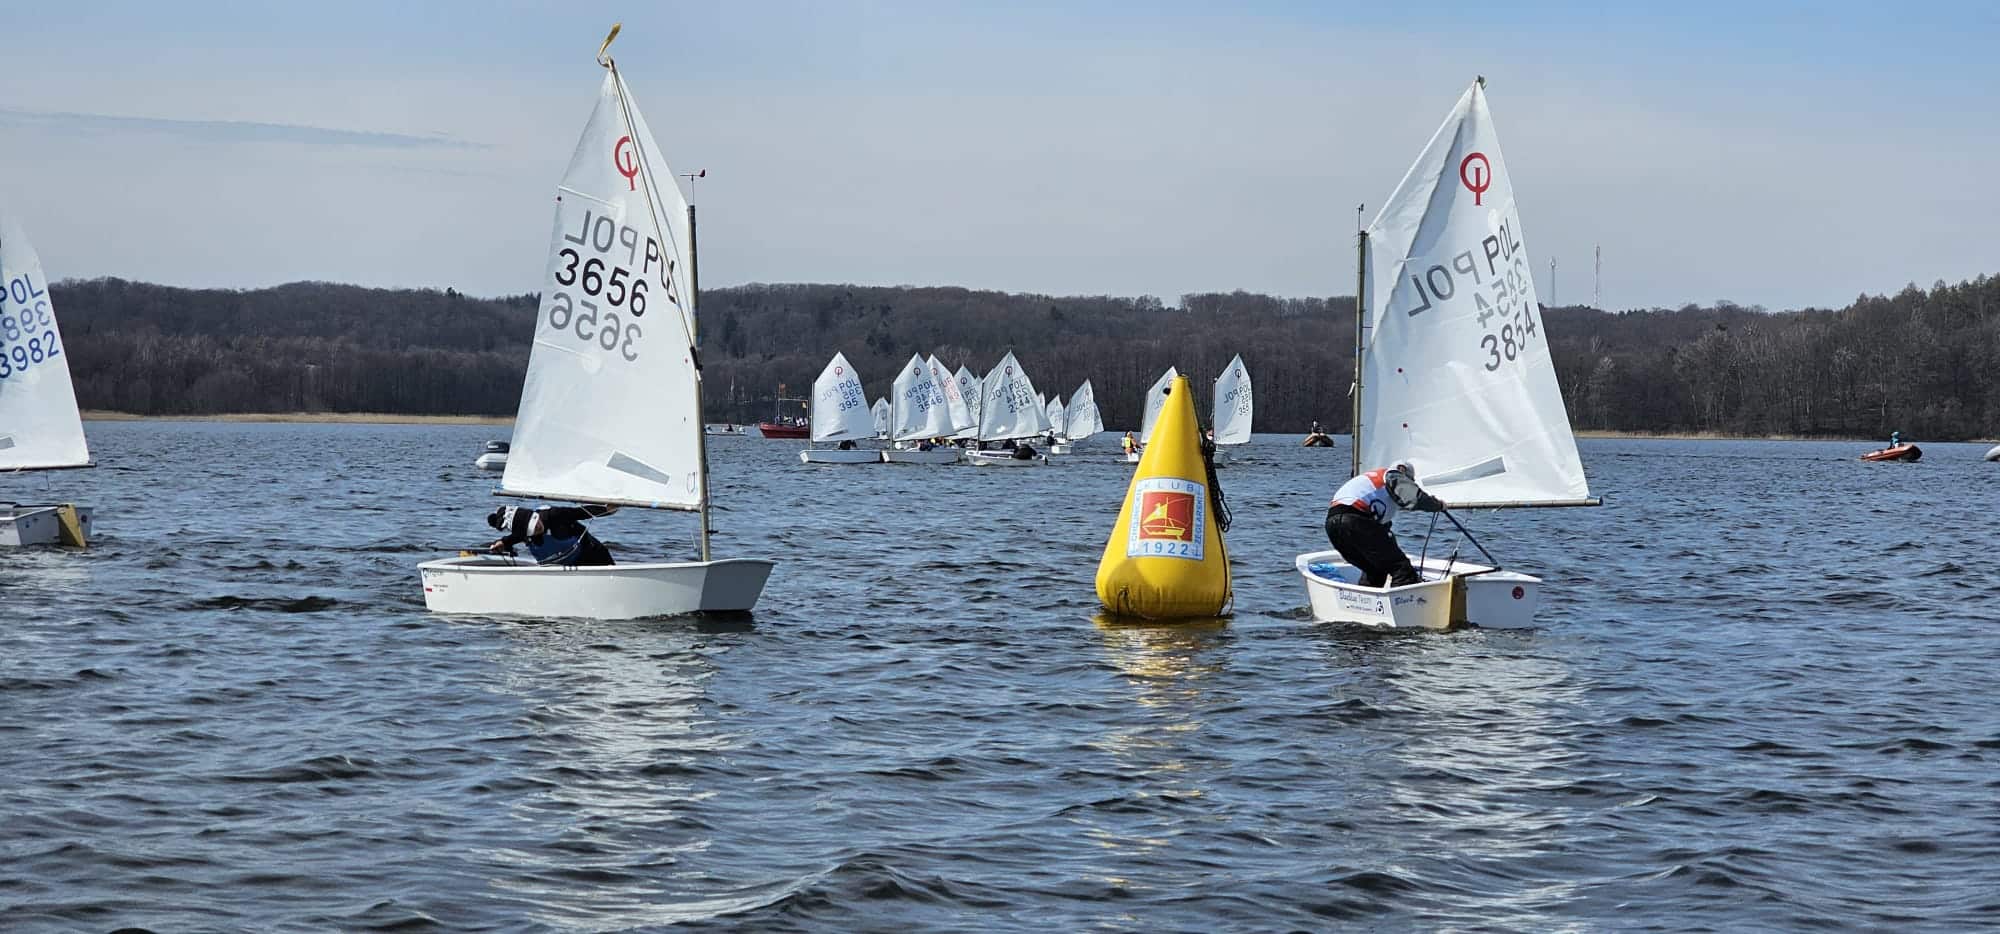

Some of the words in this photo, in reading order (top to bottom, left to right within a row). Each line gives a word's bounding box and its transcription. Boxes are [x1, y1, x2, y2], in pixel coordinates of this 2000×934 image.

[1482, 217, 1520, 276] POL
[555, 248, 649, 317] 3656
[1481, 301, 1536, 372] 3854
[0, 330, 59, 378] 3982
[839, 378, 859, 391] POL
[918, 379, 937, 393] POL
[1009, 379, 1026, 393] POL
[839, 397, 858, 412] 395
[1008, 397, 1031, 414] 2244
[1145, 480, 1194, 493] KLUB
[1143, 542, 1189, 555] 1922
